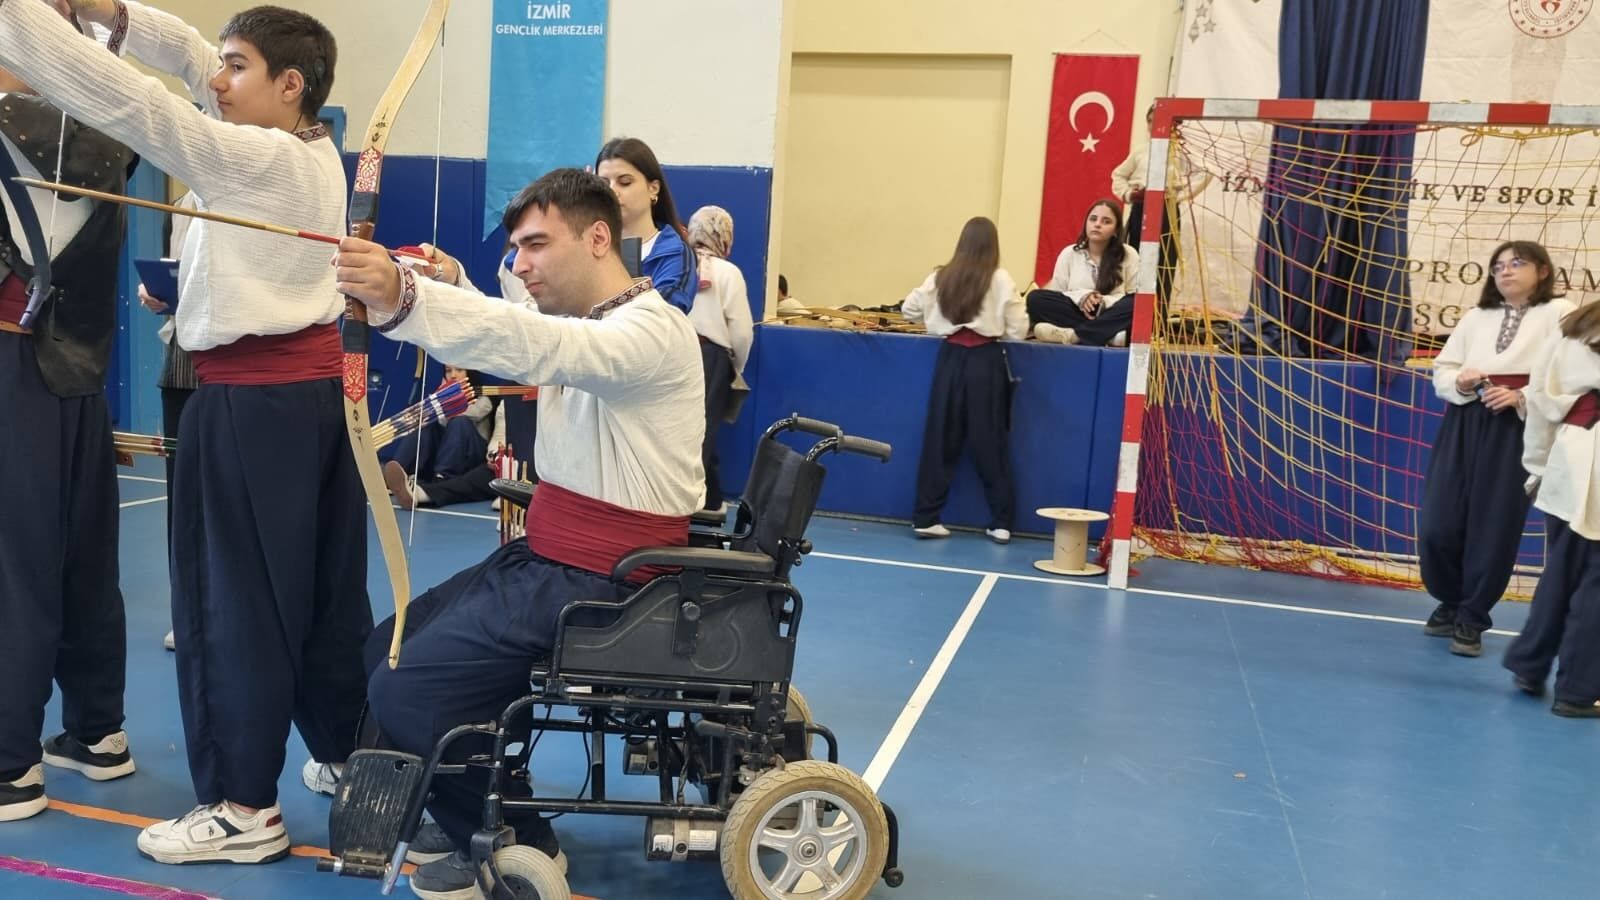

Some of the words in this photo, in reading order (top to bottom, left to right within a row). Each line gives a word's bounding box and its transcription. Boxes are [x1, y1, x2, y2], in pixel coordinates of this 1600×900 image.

[527, 0, 571, 20] İZMİR
[495, 23, 541, 36] GENÇLİK
[543, 23, 603, 36] MERKEZLERİ
[1451, 184, 1487, 203] VE
[1498, 186, 1575, 207] SPOR
[1414, 303, 1463, 333] ŞG
